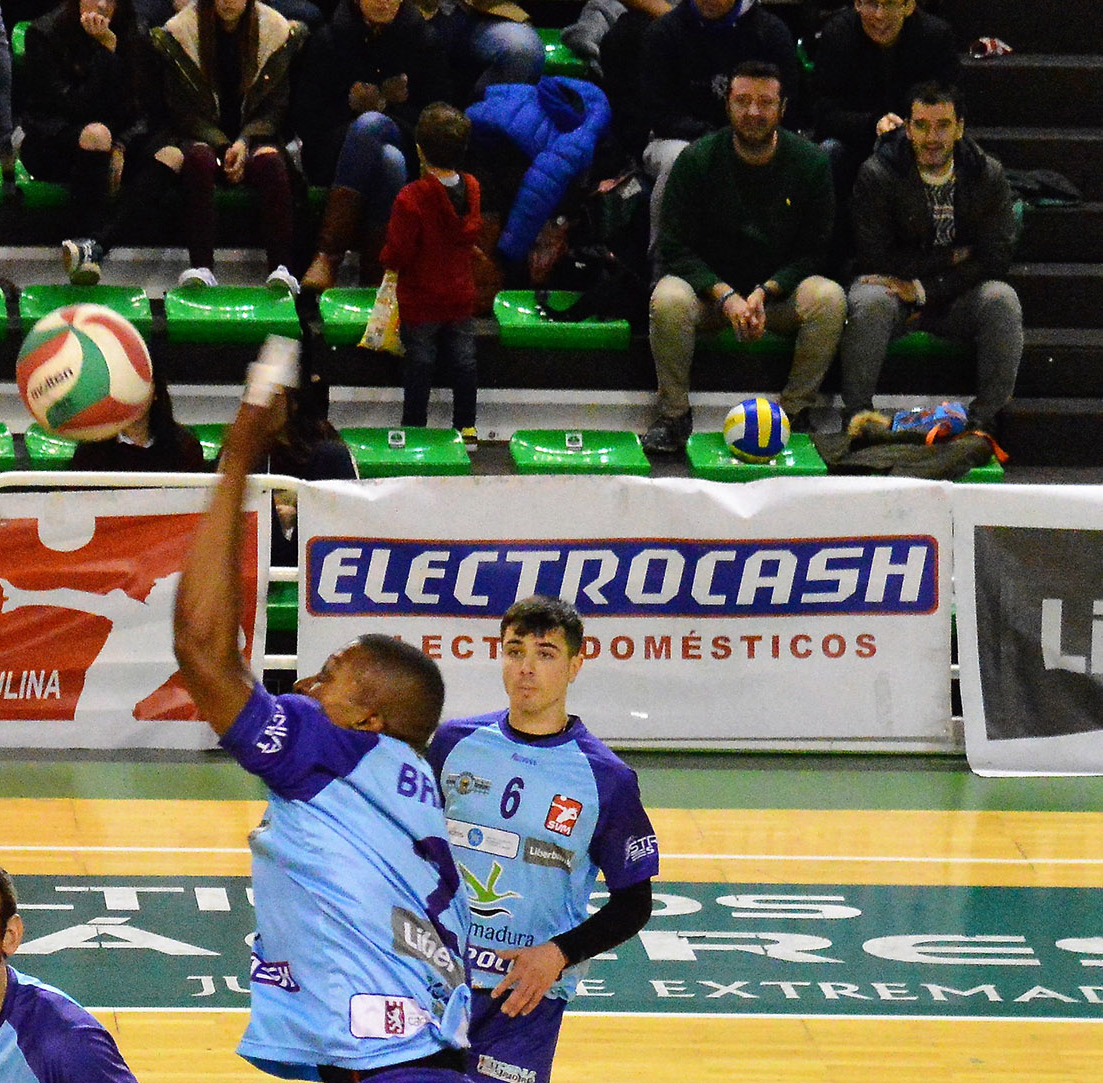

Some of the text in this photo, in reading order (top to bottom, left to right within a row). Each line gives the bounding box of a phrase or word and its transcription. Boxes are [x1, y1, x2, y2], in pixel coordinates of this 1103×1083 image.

[317, 546, 930, 607] ELECTROCASH
[500, 777, 525, 819] 6
[546, 820, 572, 836] SVM
